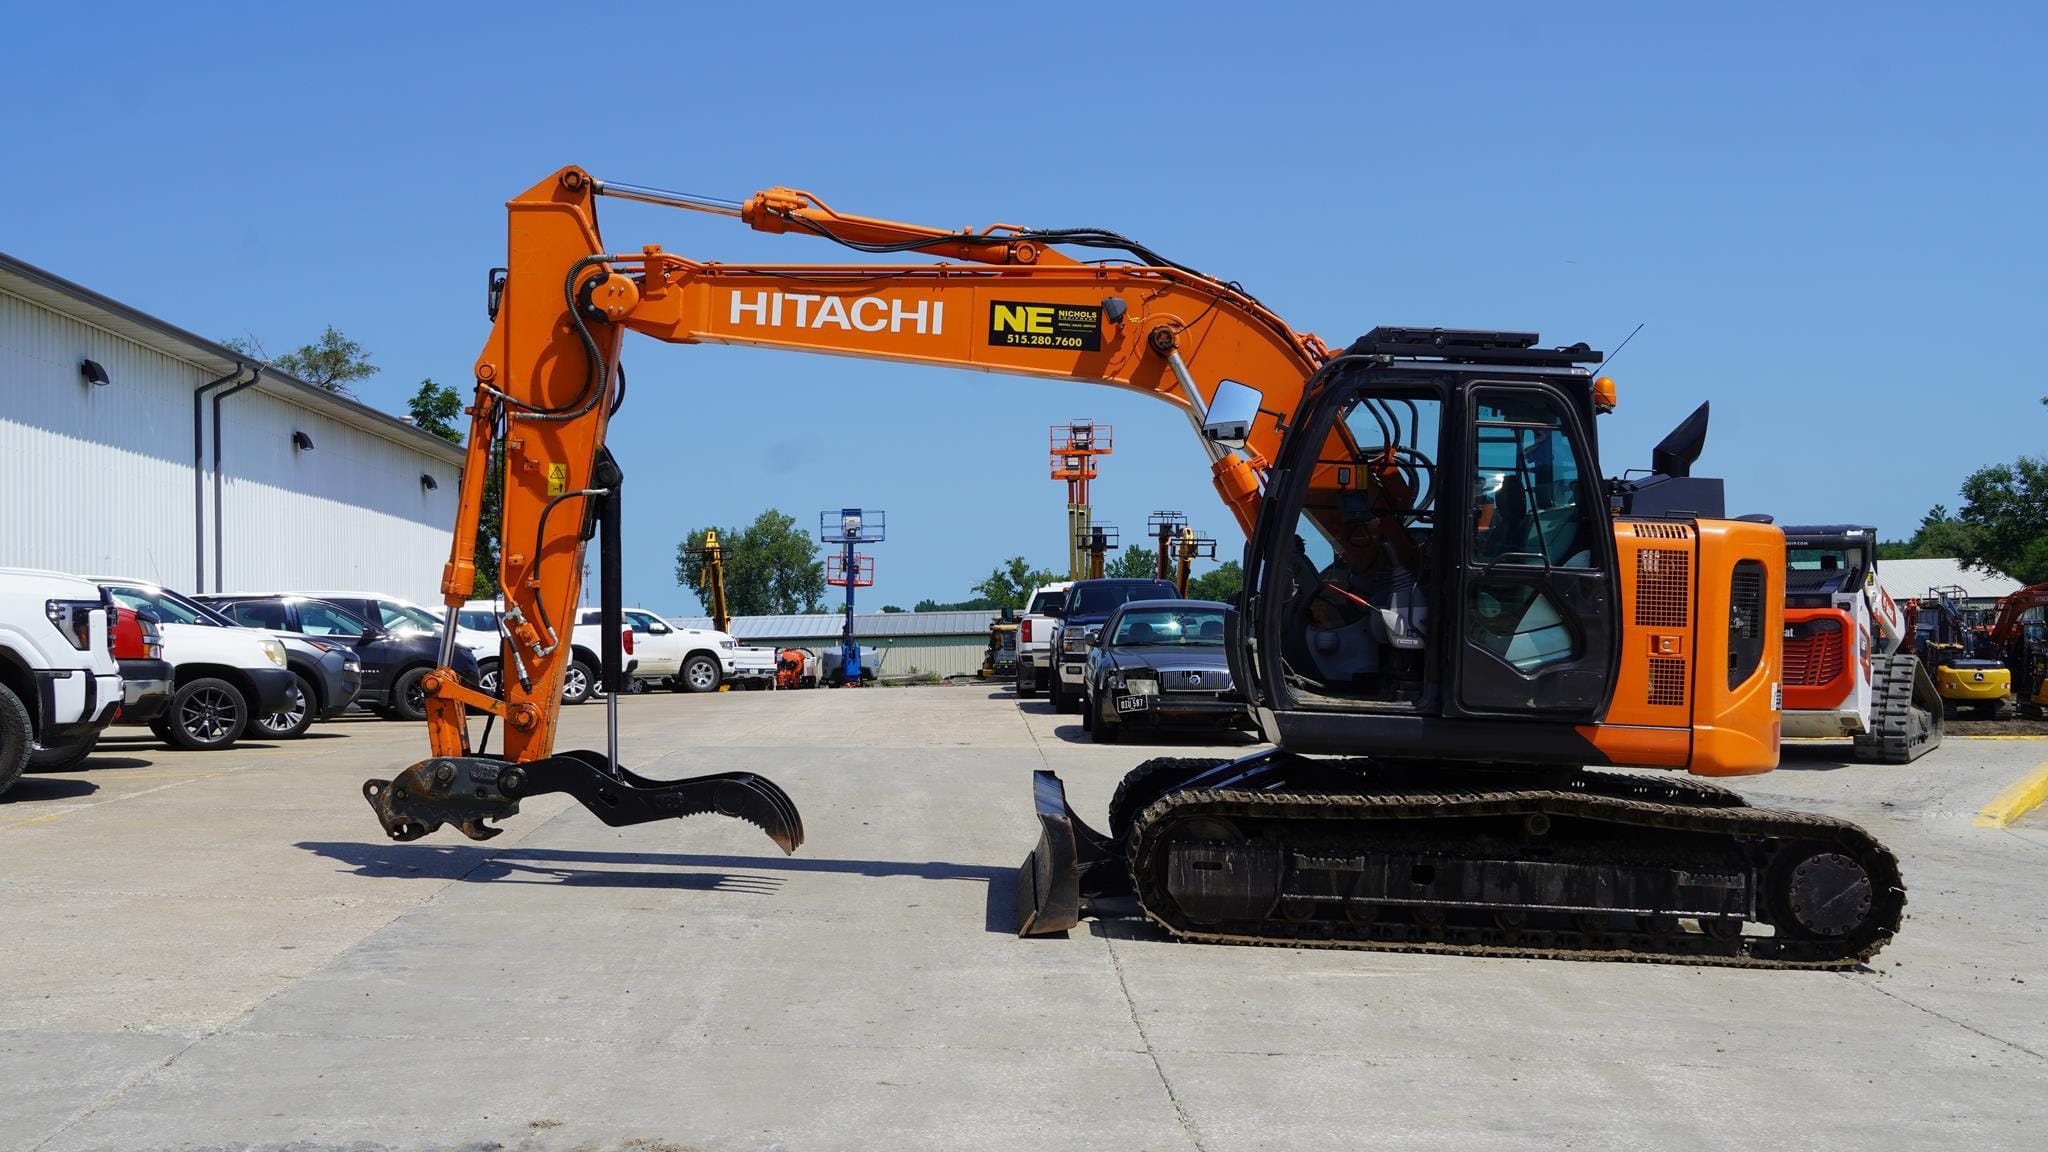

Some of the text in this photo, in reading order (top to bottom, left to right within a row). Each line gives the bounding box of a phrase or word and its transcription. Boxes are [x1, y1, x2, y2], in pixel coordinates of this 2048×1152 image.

[729, 290, 944, 335] HITACHI
[994, 304, 1055, 334] NE
[1058, 310, 1097, 319] NICHOLS
[1006, 334, 1083, 347] 515.280.7600
